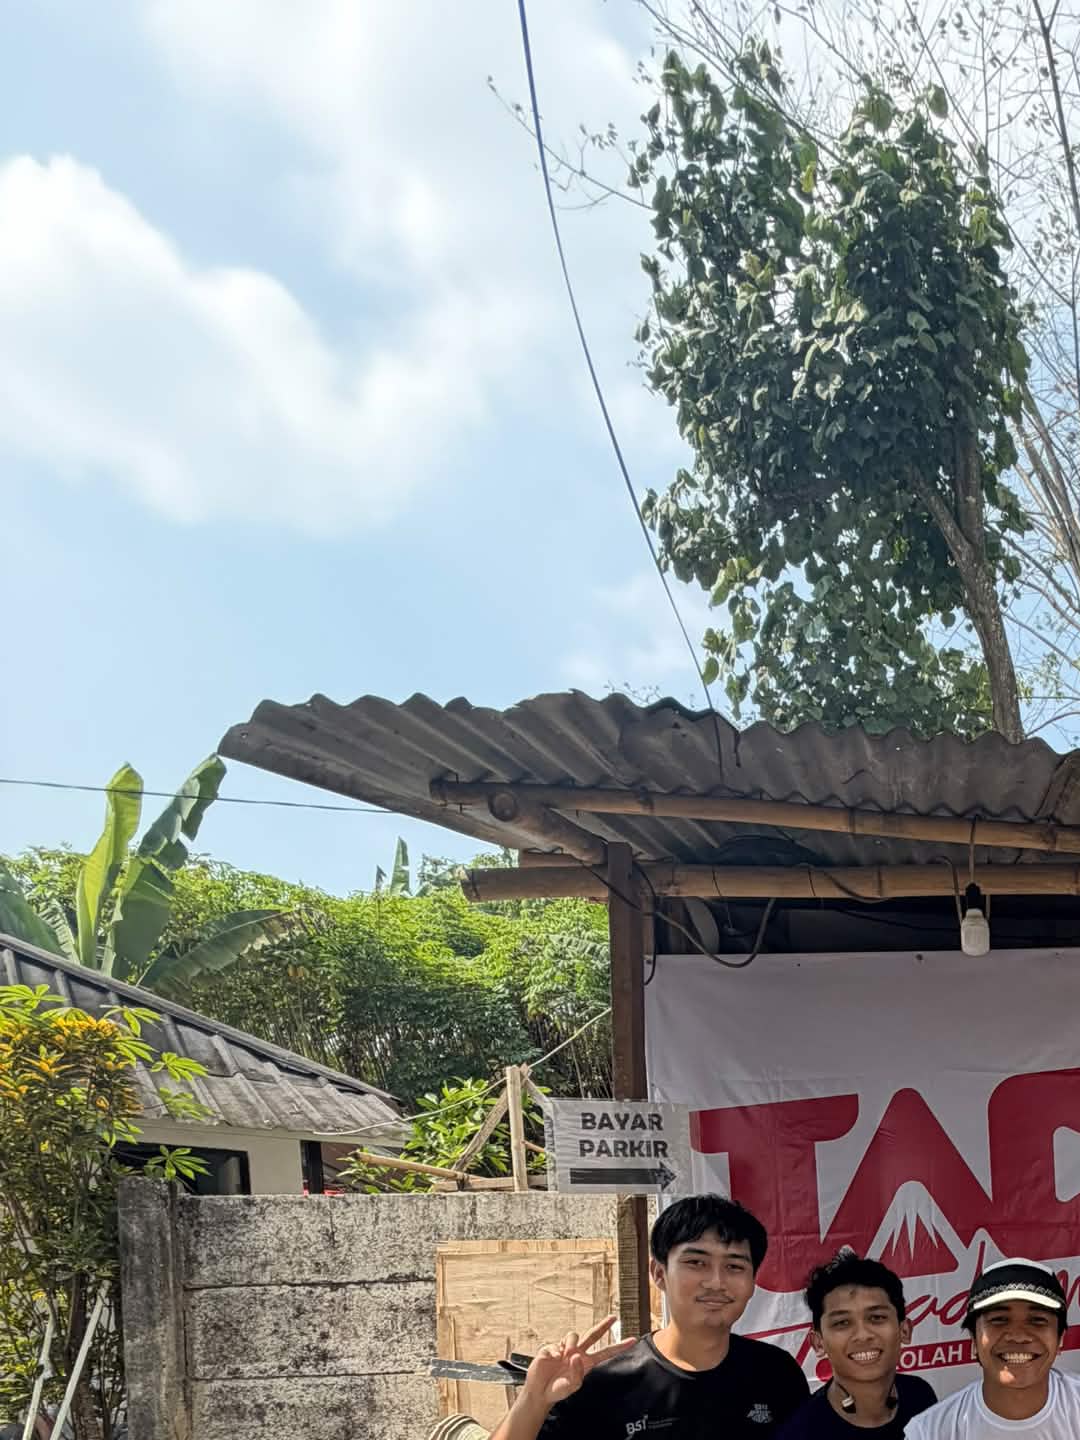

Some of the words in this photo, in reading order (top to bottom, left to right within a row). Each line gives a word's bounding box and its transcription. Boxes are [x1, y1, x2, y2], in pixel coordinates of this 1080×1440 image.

[580, 1111, 664, 1131] BAYAR
[578, 1139, 669, 1159] PARKIR
[898, 1343, 963, 1369] OLAH
